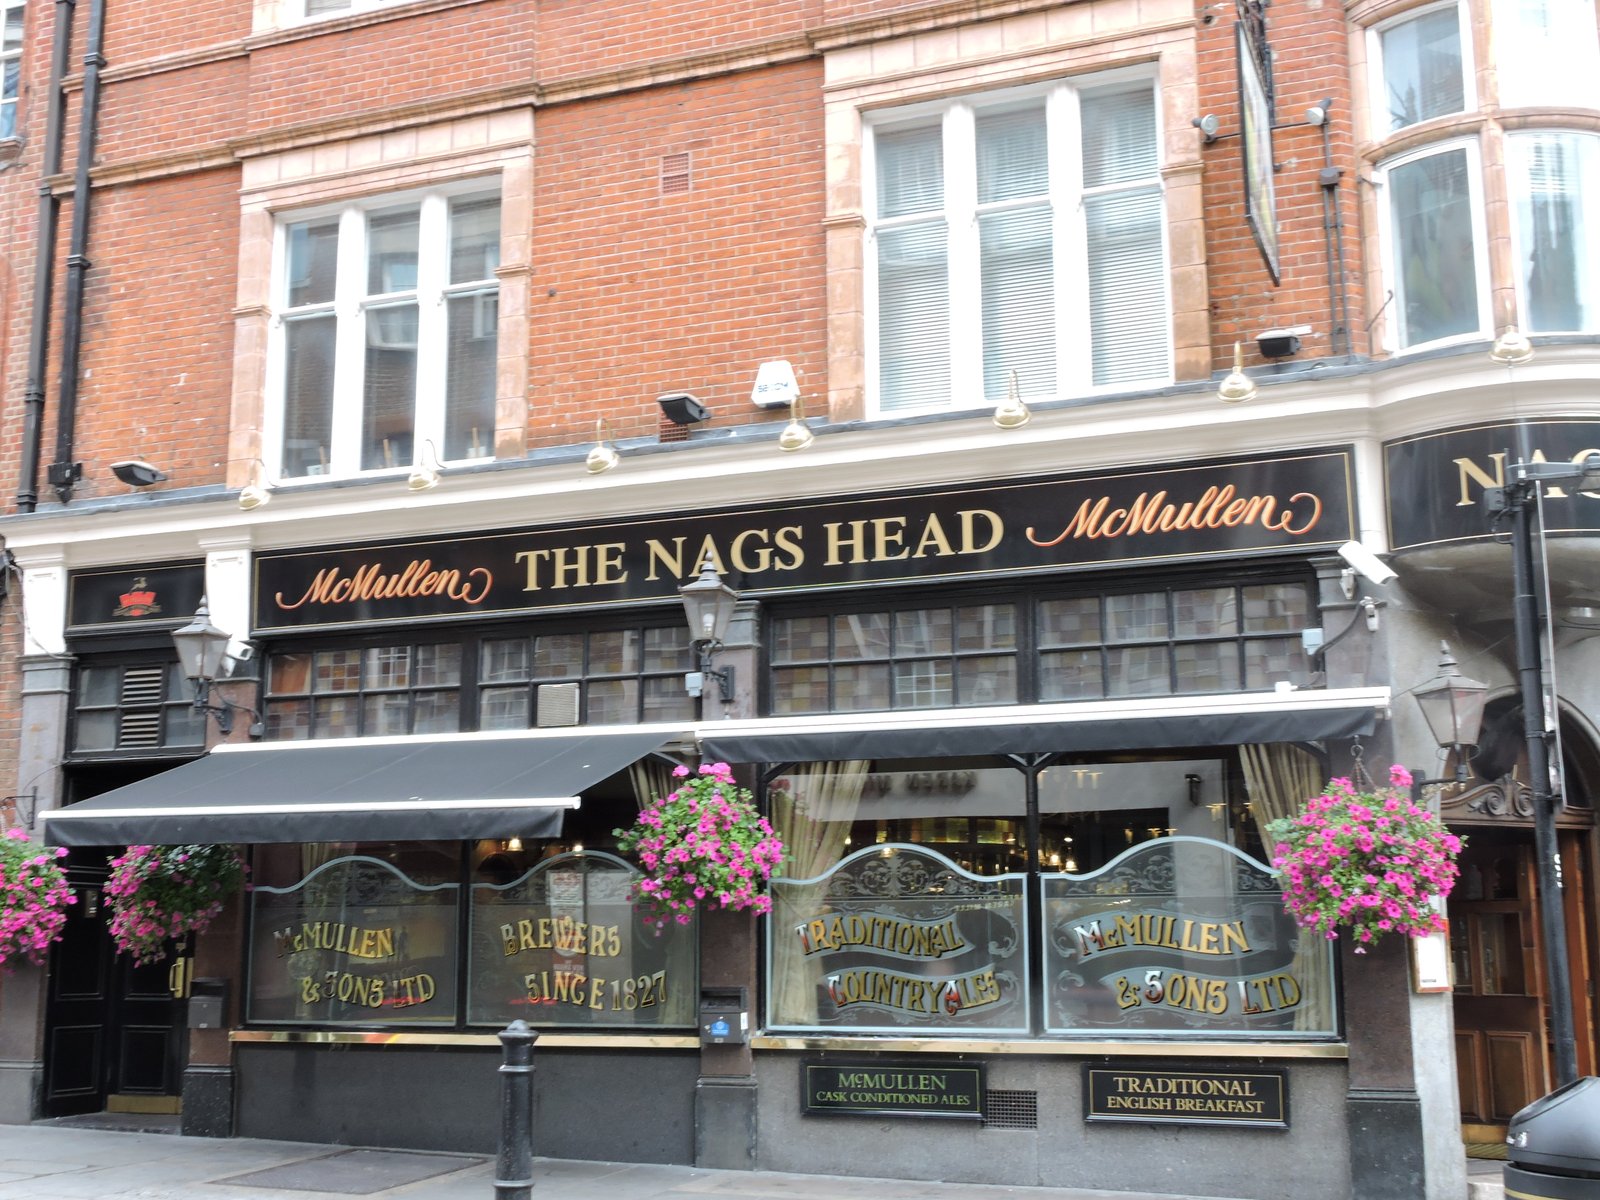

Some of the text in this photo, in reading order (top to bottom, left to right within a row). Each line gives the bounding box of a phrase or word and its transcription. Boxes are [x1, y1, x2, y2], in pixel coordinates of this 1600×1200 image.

[1025, 484, 1323, 547] McMullen
[515, 509, 1005, 592] THE NAGS HEAD
[275, 559, 493, 610] McMullen
[272, 921, 395, 958] McMULLEN
[500, 916, 622, 957] BREWERS
[794, 915, 965, 958] TRADITIONAL
[1073, 914, 1252, 956] McMULLEN
[301, 970, 436, 1009] & SONS LTD
[525, 970, 667, 1011] SINCE 1827
[828, 971, 1001, 1015] COUNTRY ALES
[1115, 970, 1301, 1014] & SONS LTD
[816, 1091, 970, 1106] CASK CONDITIONED ALES
[838, 1073, 947, 1090] McMULLEN
[1113, 1077, 1256, 1097] TRADITIONAL
[1107, 1096, 1265, 1114] ENGLISH BREAKFAST
